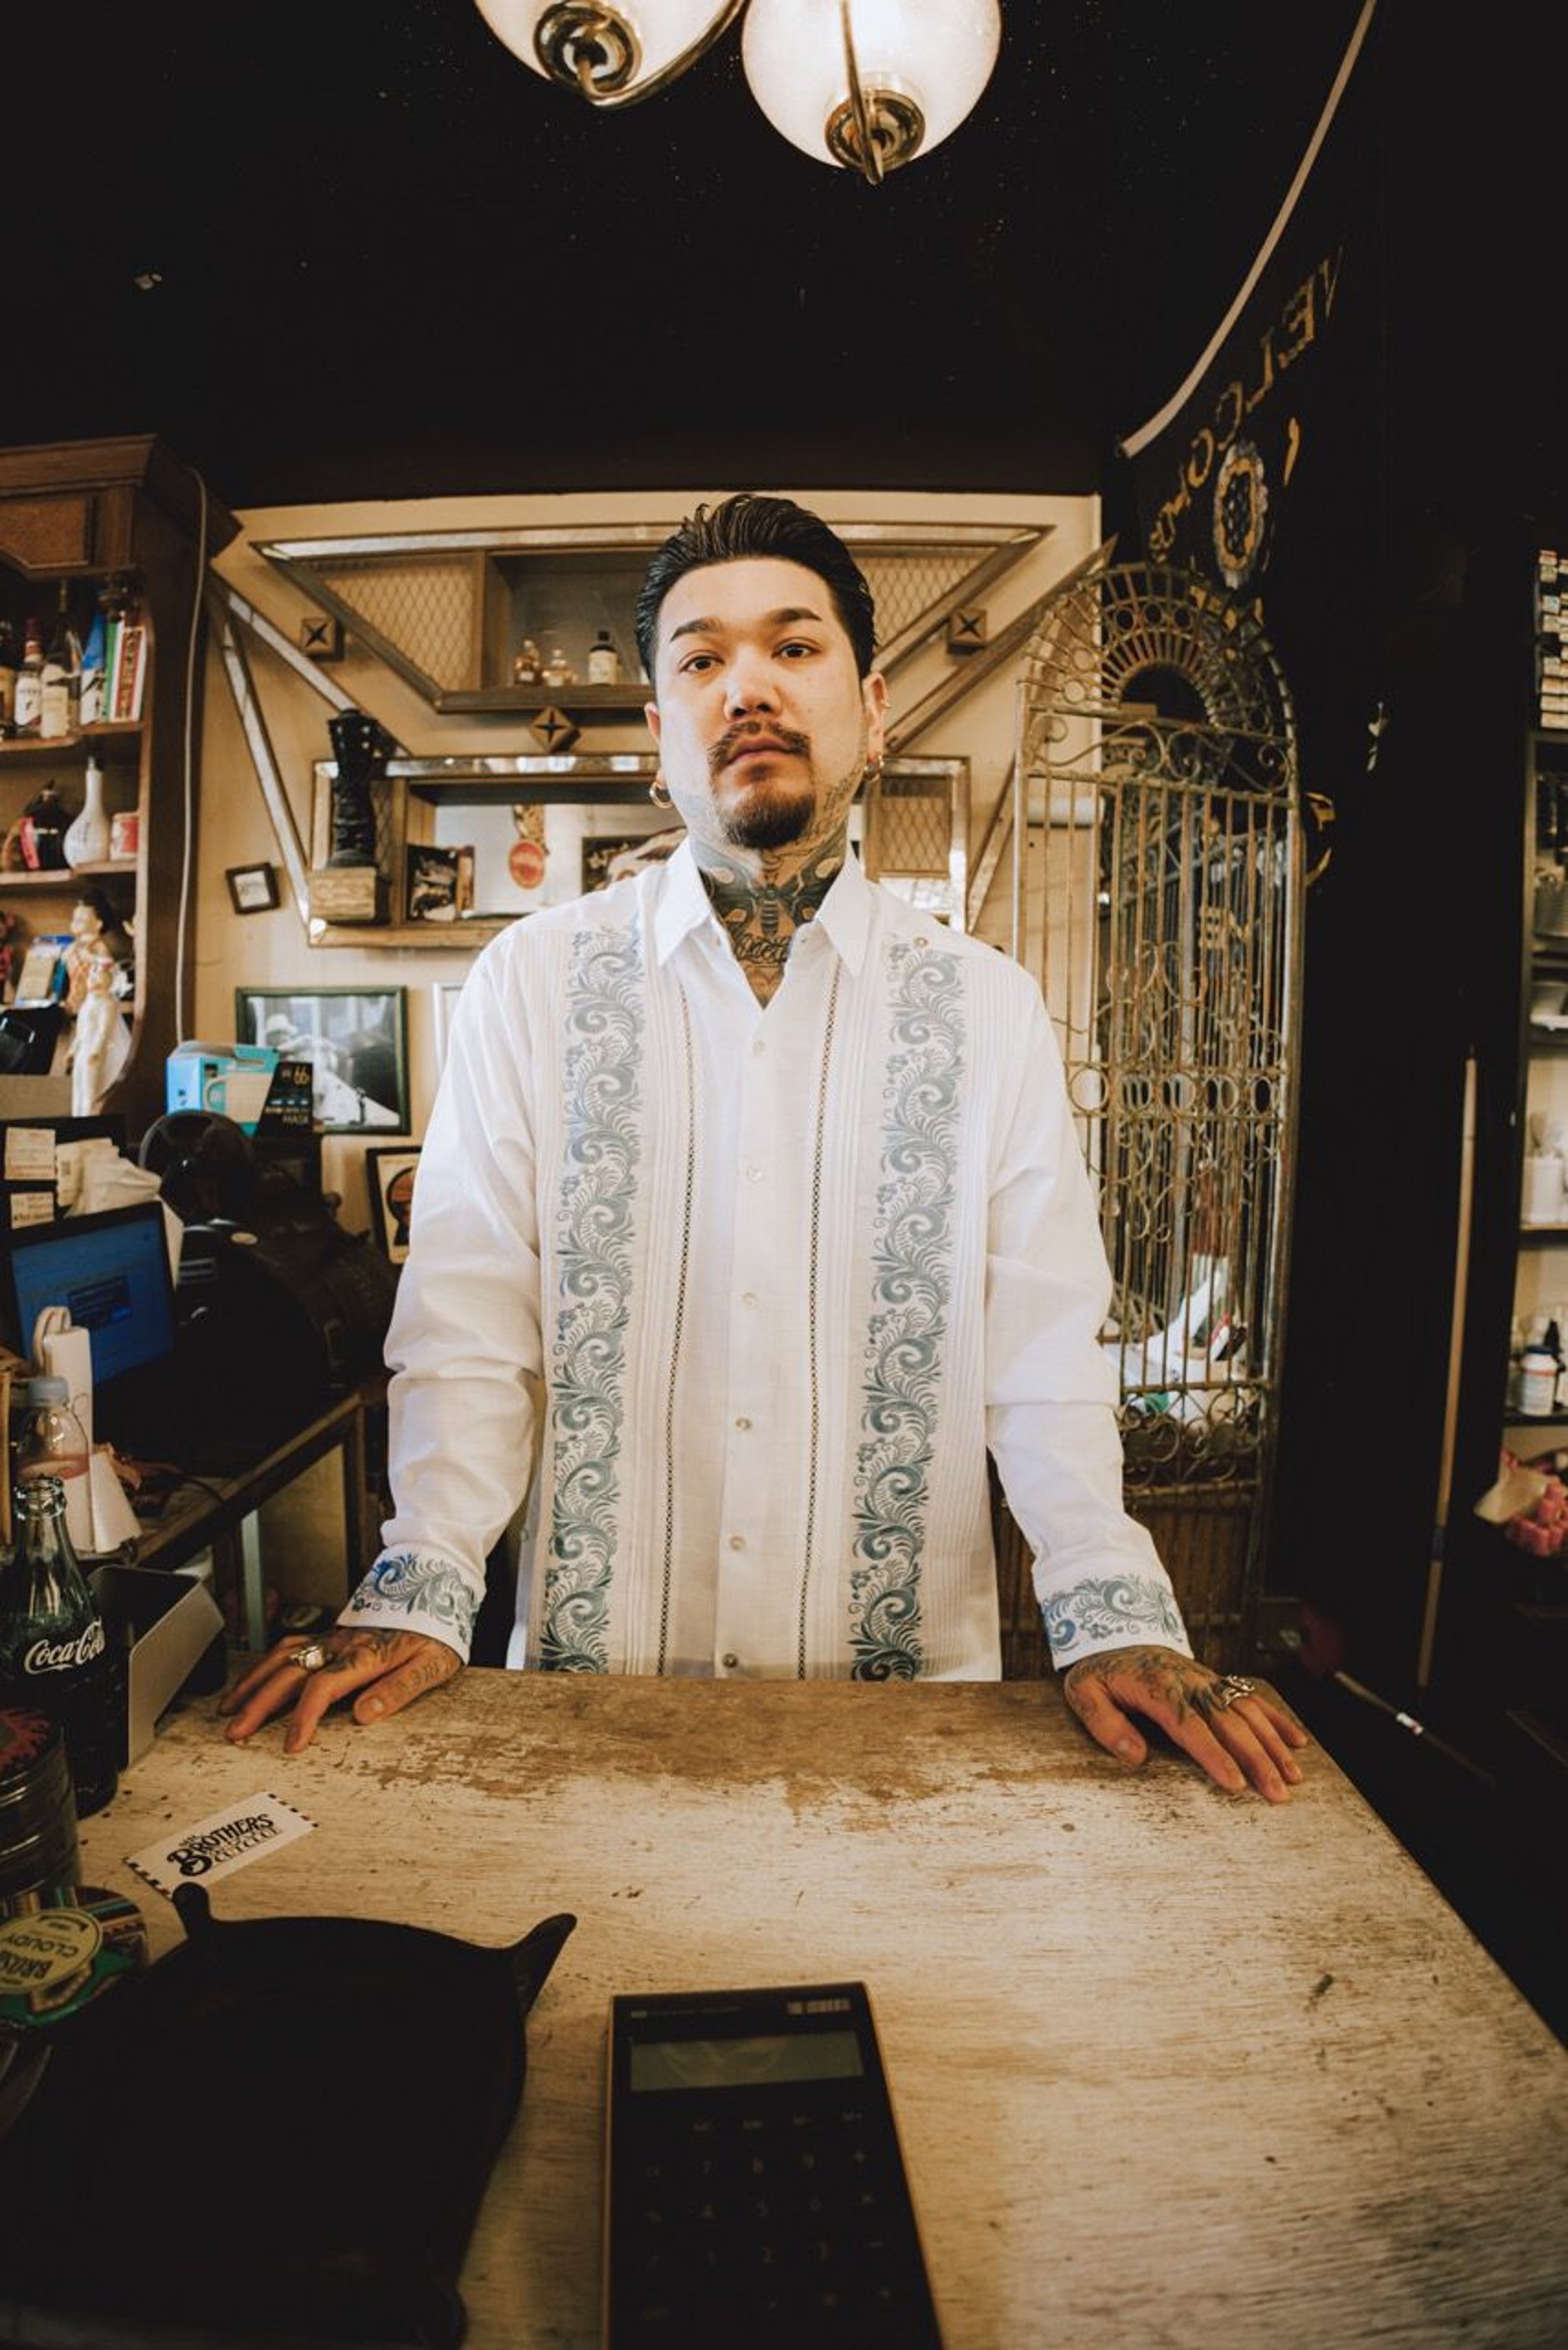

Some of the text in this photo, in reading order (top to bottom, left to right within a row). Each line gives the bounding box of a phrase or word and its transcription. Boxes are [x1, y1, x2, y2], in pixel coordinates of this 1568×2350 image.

[24, 1616, 105, 1674] Coca-Cola
[167, 1814, 274, 1876] BROTHERS
[1, 1933, 79, 1958] CLOUDY
